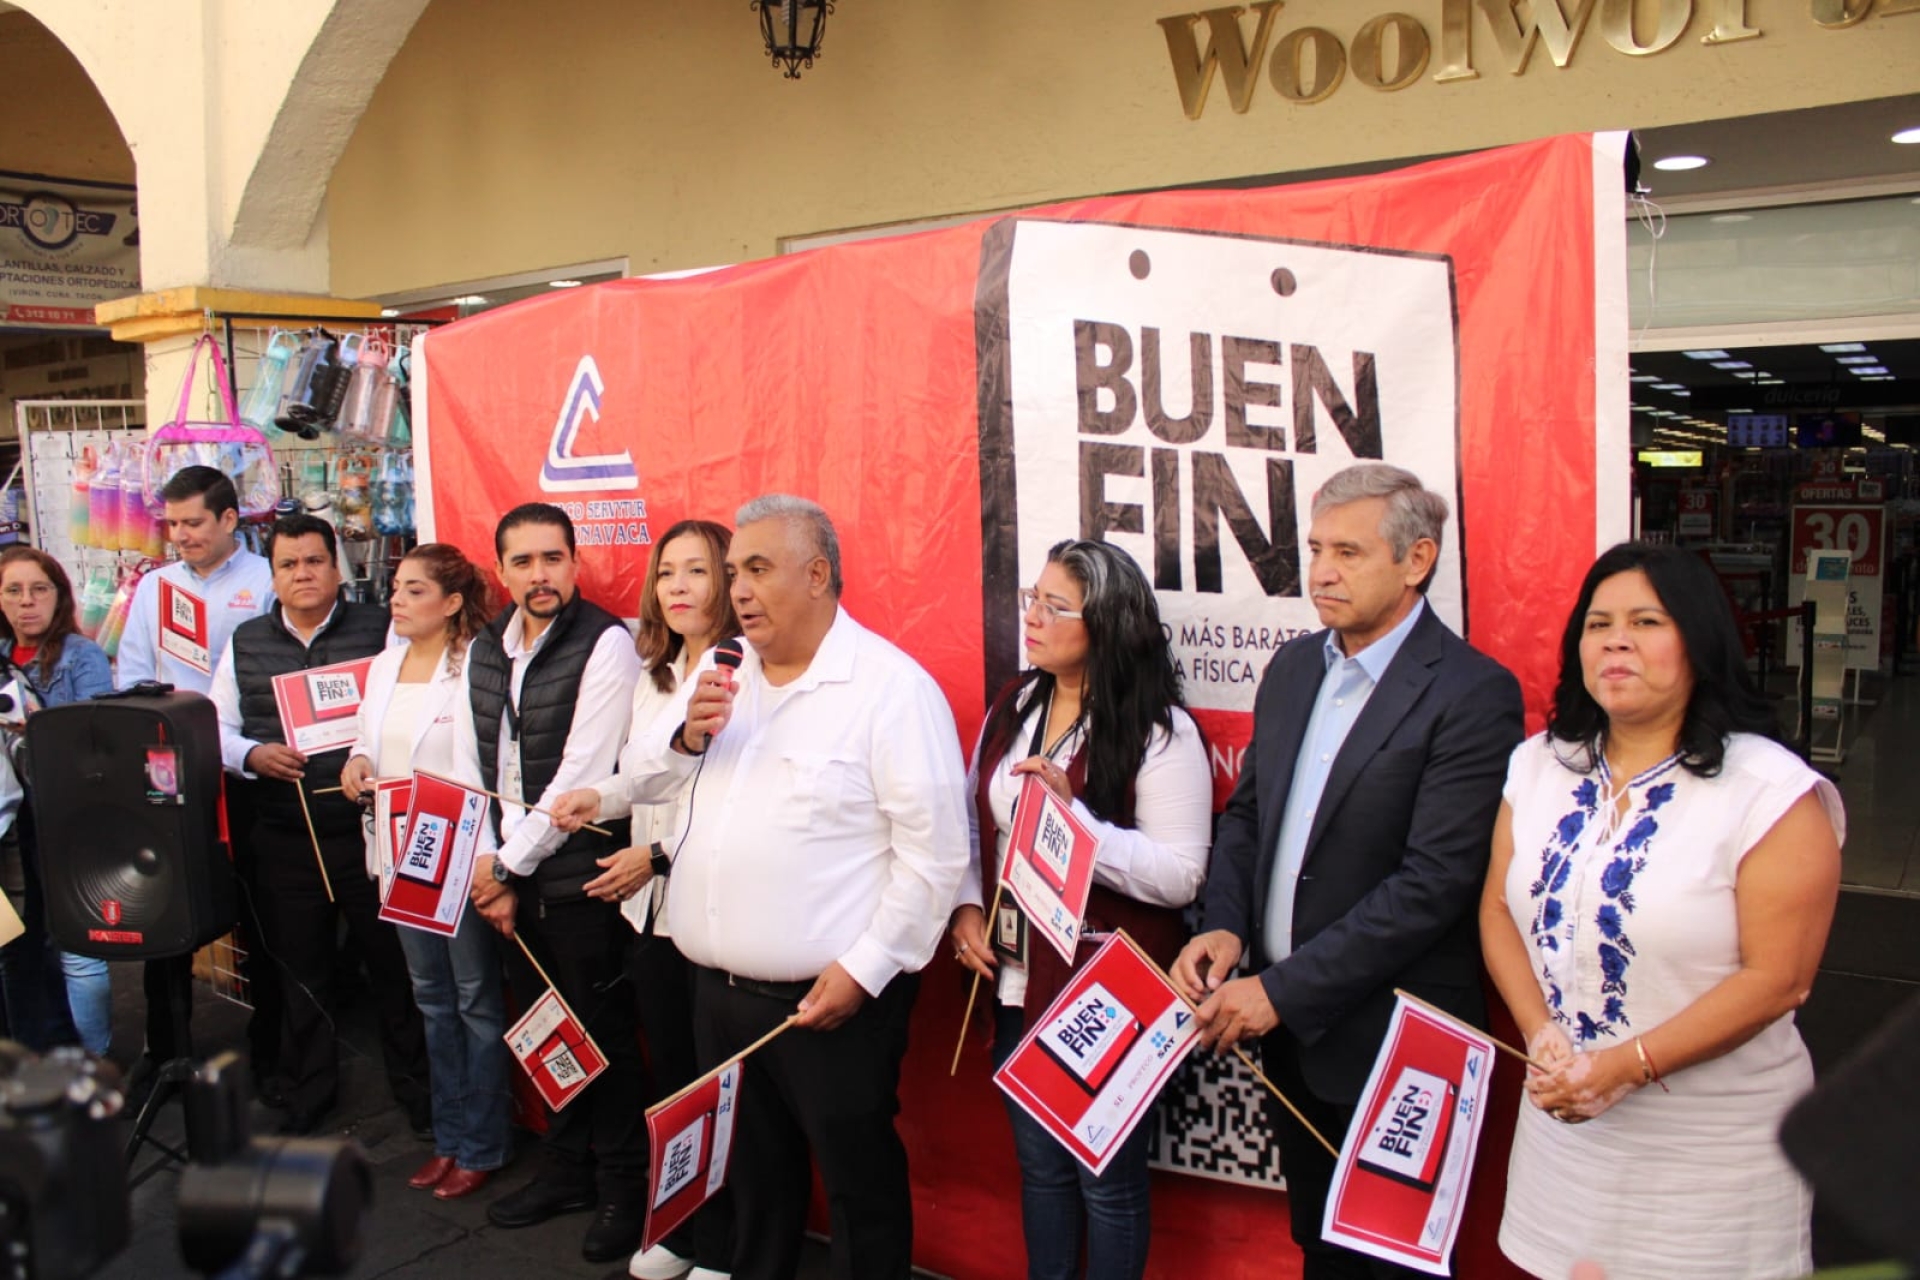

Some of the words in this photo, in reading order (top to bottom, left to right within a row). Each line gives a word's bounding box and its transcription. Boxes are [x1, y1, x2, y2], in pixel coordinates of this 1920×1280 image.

[1073, 319, 1384, 460] BUEN
[1800, 487, 1852, 500] OFERTAS
[1078, 440, 1303, 598] FIN
[1804, 512, 1871, 562] 30
[1180, 617, 1226, 649] MÁS
[316, 679, 349, 691] BUEN
[1193, 652, 1255, 683] FÍSICA
[319, 687, 344, 702] FIN
[409, 822, 431, 867] BUEN
[1041, 825, 1060, 858] FIN
[1045, 812, 1069, 850] BUEN
[418, 836, 437, 870] FIN
[1057, 998, 1104, 1045] BUEN
[1069, 1017, 1107, 1059] FIN
[1157, 1036, 1176, 1059] SAT
[1378, 1084, 1421, 1152] BUEN
[1393, 1105, 1429, 1159] FIN
[664, 1141, 682, 1193] BUEN
[675, 1143, 693, 1182] FIN
